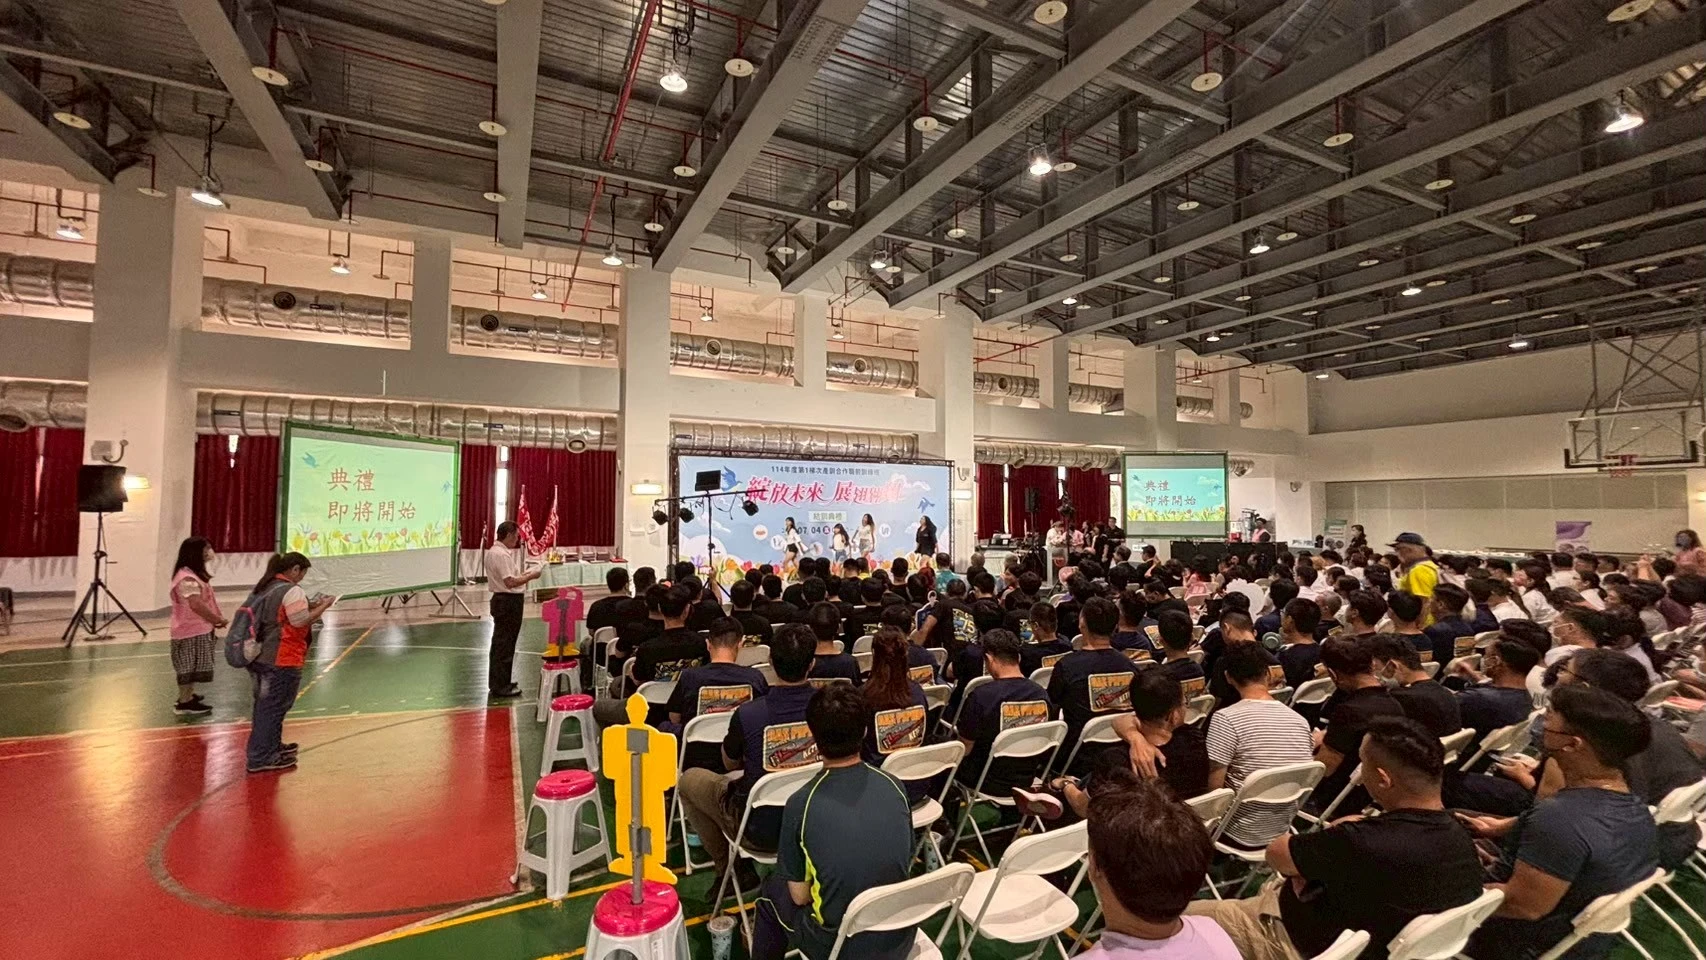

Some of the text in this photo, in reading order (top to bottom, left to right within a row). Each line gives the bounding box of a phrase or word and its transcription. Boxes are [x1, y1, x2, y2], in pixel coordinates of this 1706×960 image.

[327, 467, 376, 492] 典禮
[1143, 480, 1170, 492] 典禮
[1144, 495, 1197, 507] 即將開始
[327, 500, 416, 524] 即將開始
